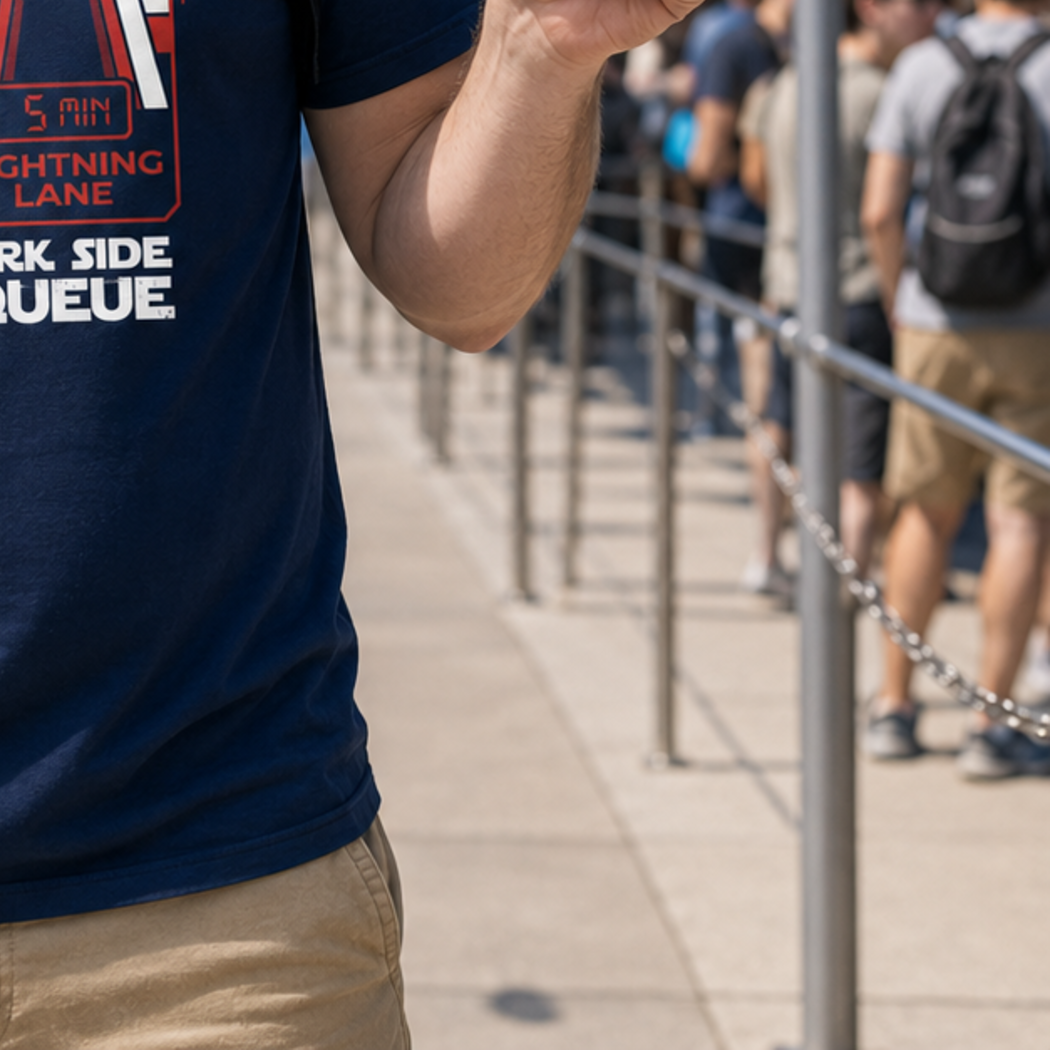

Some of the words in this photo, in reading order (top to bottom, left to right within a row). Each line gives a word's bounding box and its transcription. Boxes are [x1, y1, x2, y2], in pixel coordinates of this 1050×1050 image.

[25, 95, 46, 130] 5
[60, 99, 109, 125] MIN
[16, 182, 112, 207] LANE
[72, 236, 172, 270] SIDE
